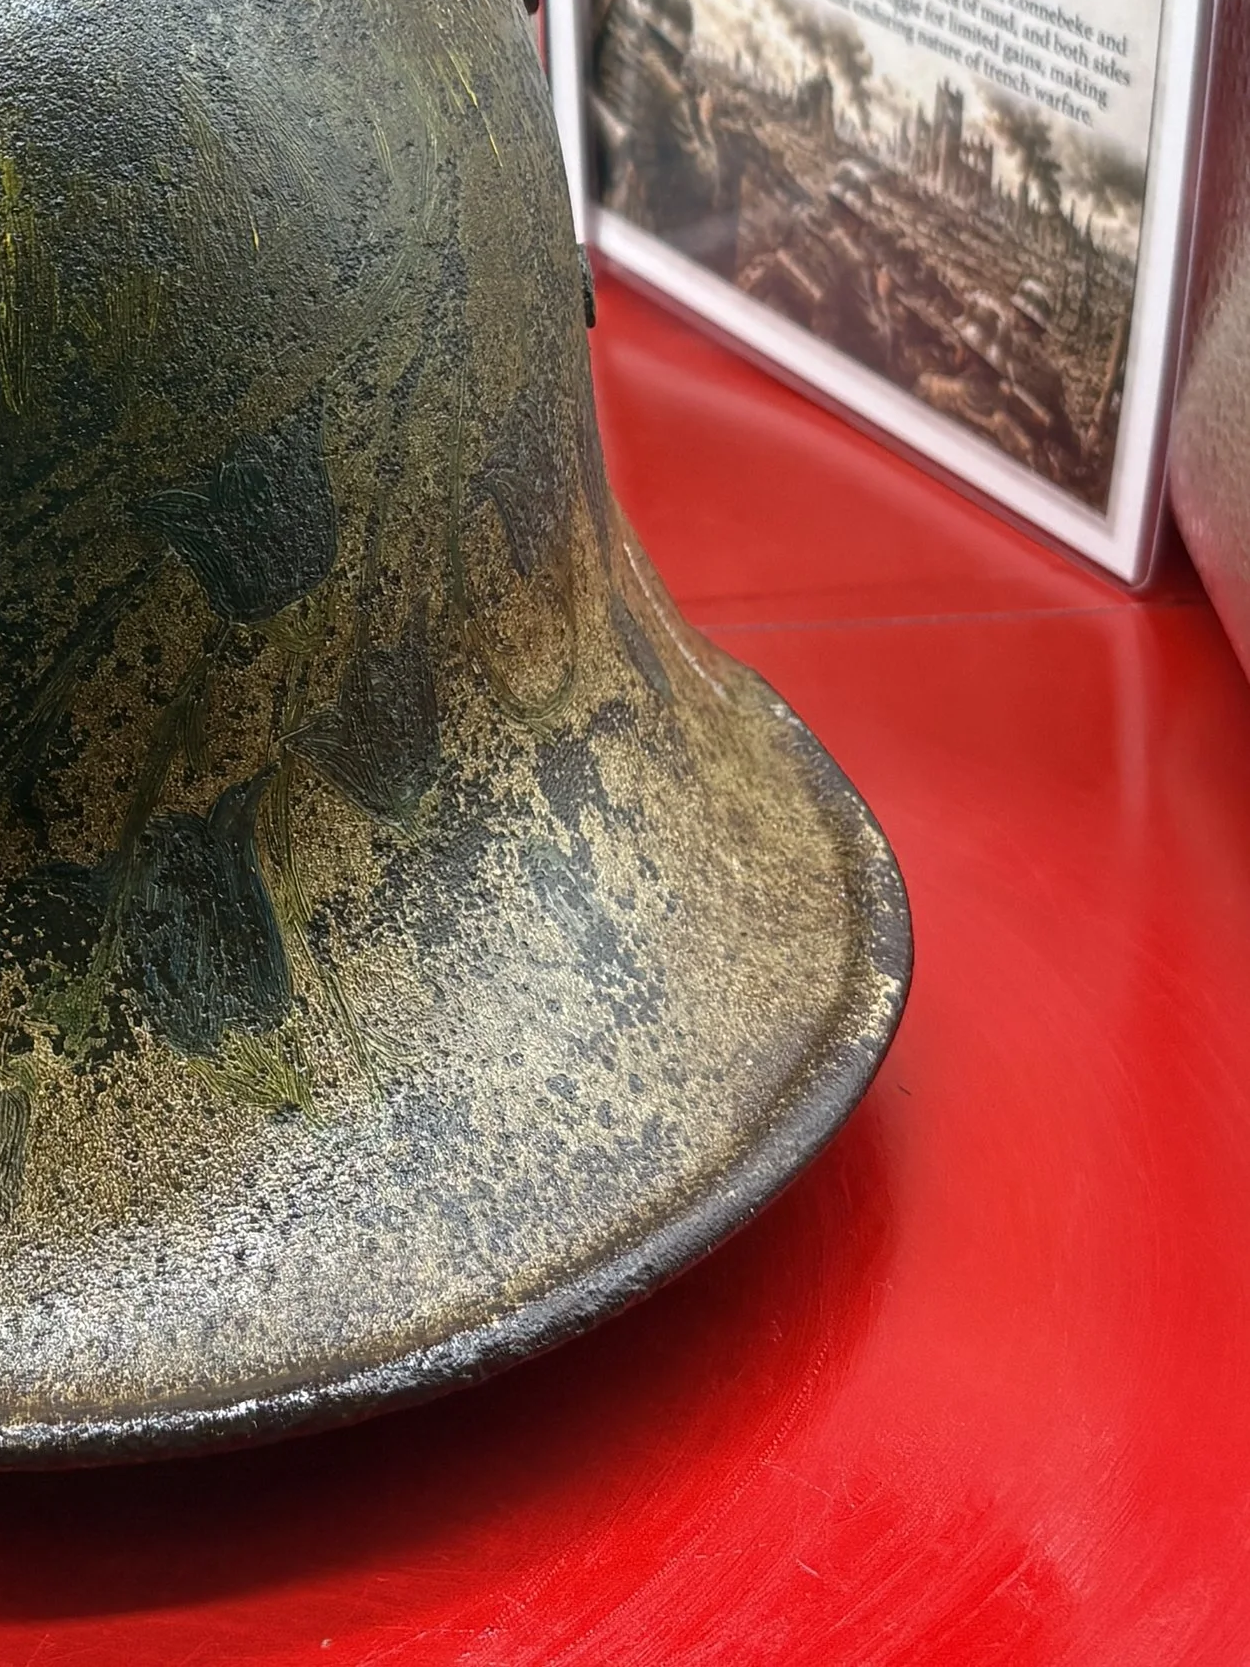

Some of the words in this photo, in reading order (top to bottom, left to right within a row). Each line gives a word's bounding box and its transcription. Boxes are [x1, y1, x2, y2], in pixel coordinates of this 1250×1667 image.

[948, 10, 999, 54] limited
[1050, 65, 1107, 112] making
[1022, 24, 1050, 51] and
[1054, 30, 1088, 68] both
[1092, 53, 1130, 87] sides
[1096, 31, 1127, 57] and
[964, 49, 982, 74] of
[983, 53, 1030, 97] trench
